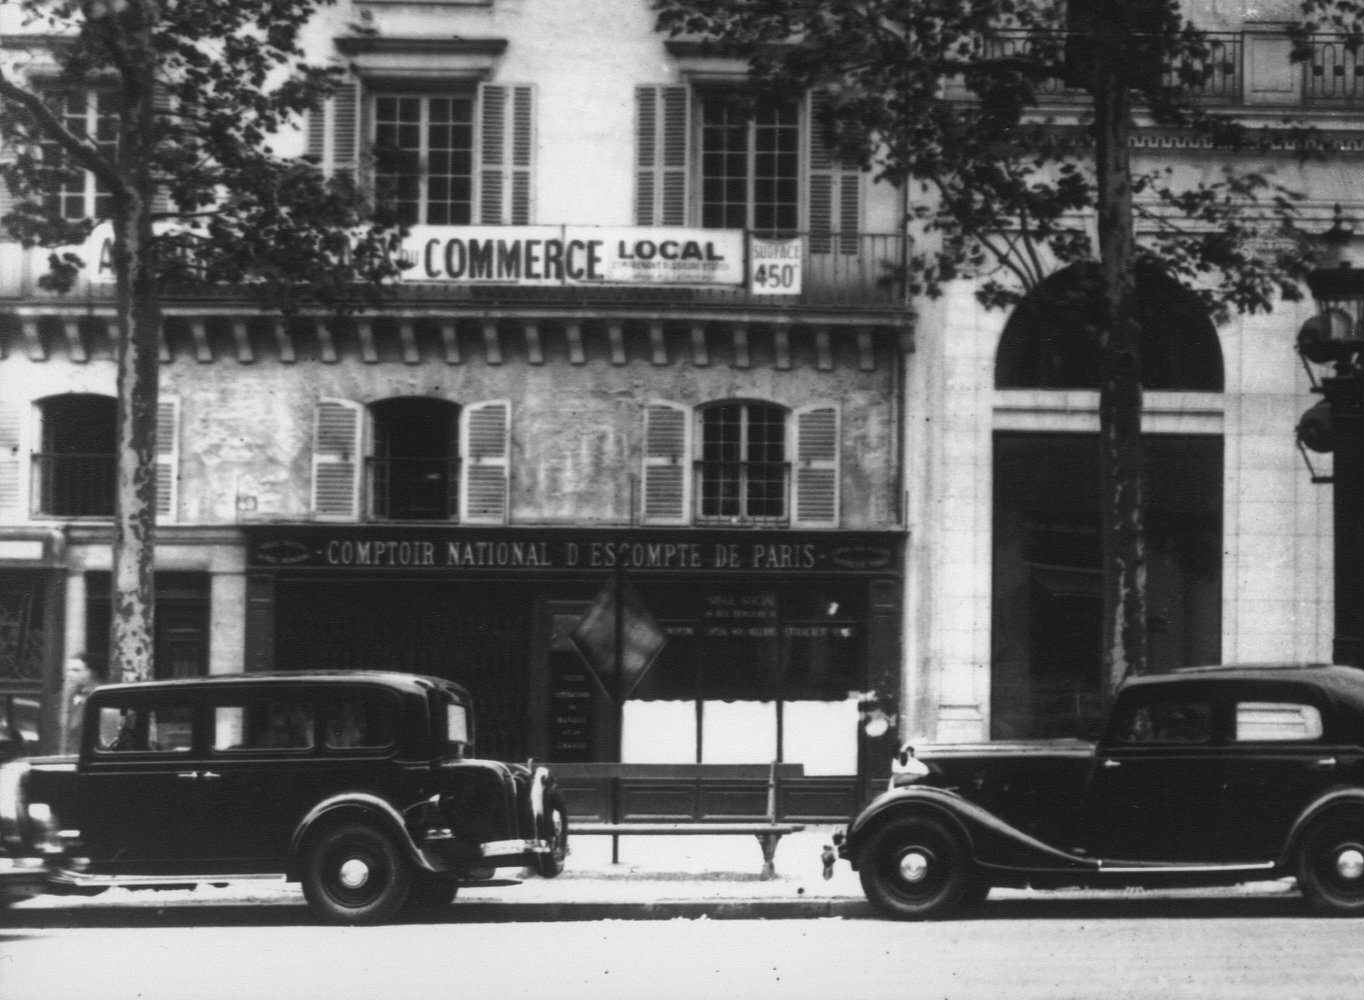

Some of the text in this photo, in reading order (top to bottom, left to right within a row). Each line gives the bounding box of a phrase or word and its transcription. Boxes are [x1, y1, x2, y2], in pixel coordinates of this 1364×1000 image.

[424, 238, 605, 280] COMMERCE
[618, 240, 725, 261] LOCAL
[327, 541, 435, 566] COMPTOIR
[448, 542, 552, 567] NATIONAL
[715, 544, 741, 567] DE
[753, 544, 816, 568] PARIS
